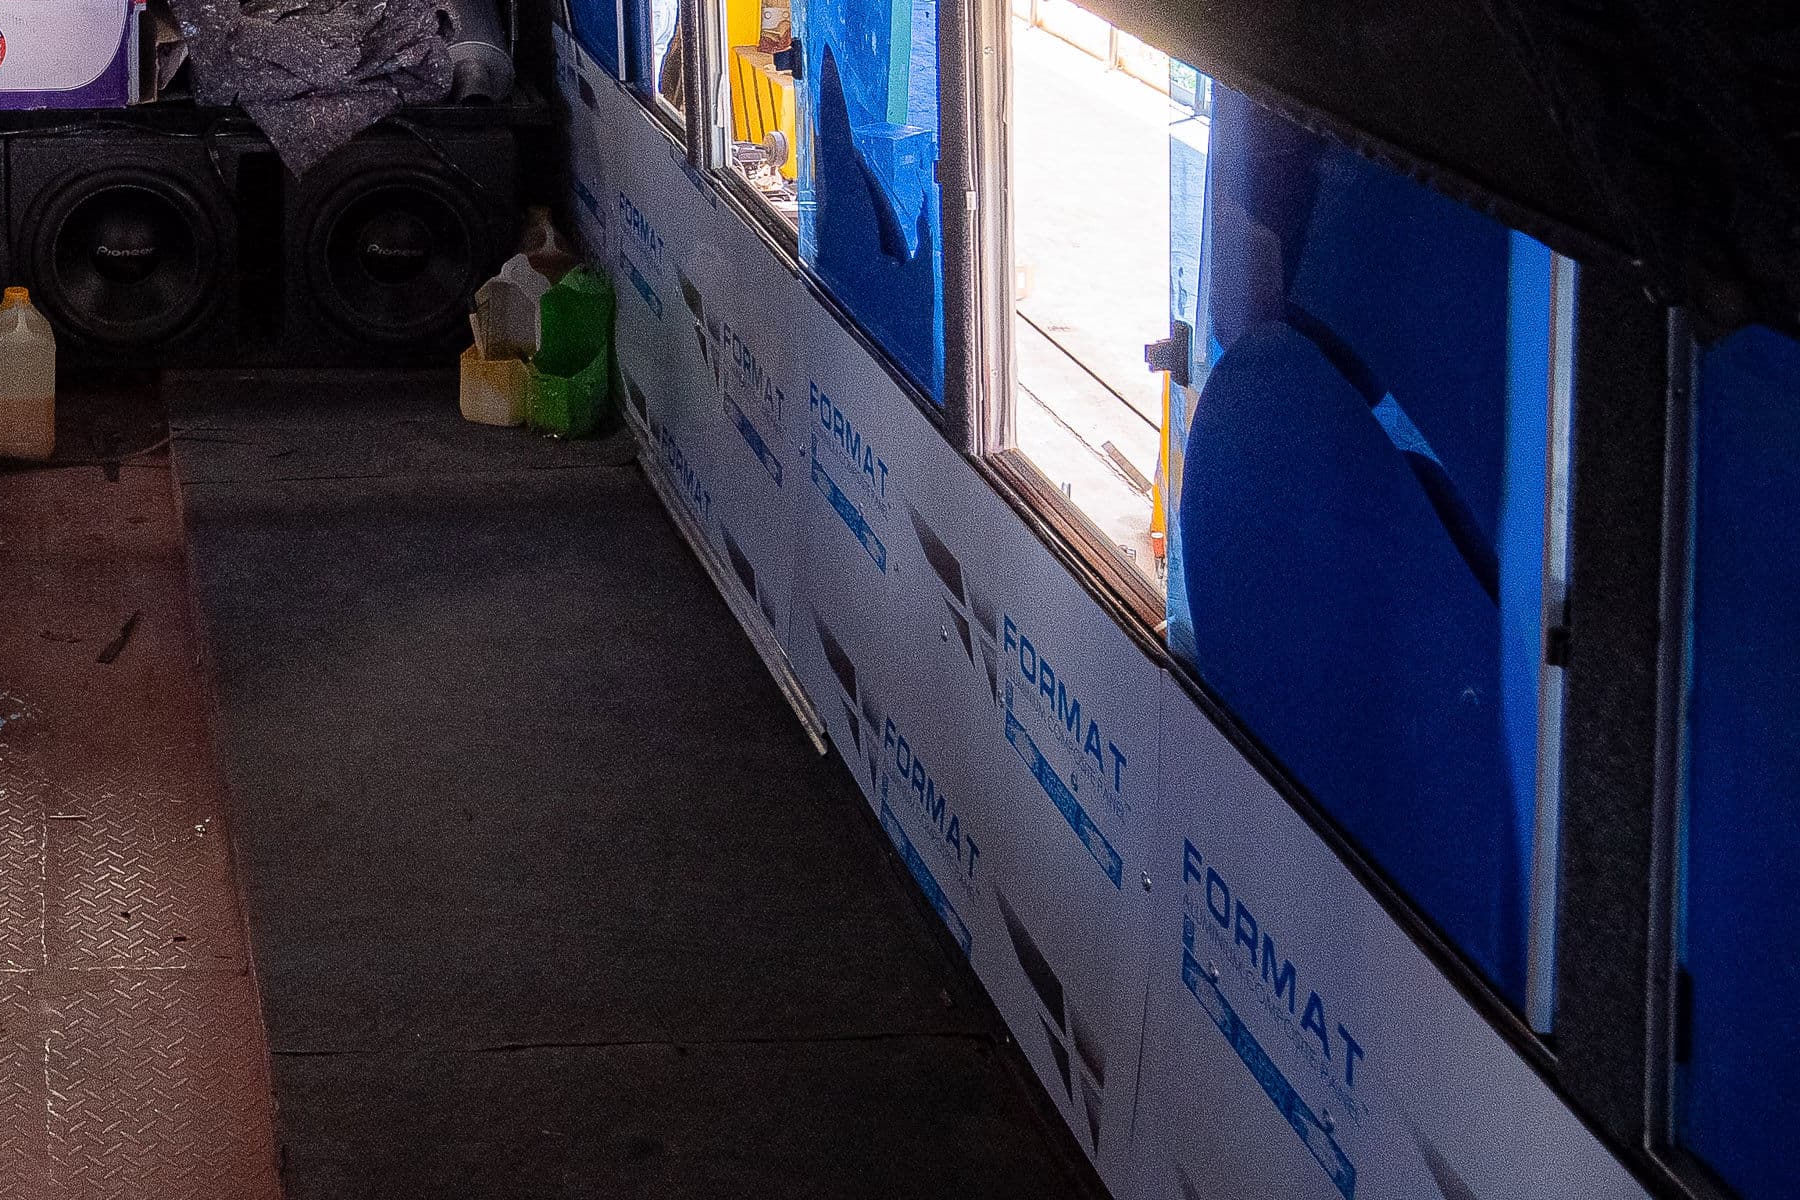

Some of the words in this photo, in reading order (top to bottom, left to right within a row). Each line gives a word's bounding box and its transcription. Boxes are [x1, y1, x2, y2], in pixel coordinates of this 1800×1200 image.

[619, 190, 664, 265] FORMAT
[723, 322, 785, 420] FORMAT
[661, 424, 712, 518] FORMAT
[809, 375, 889, 498] FORMAT
[1003, 613, 1127, 793] FORMAT
[884, 715, 980, 879] FORMAT
[1182, 836, 1365, 1087] FORMAT
